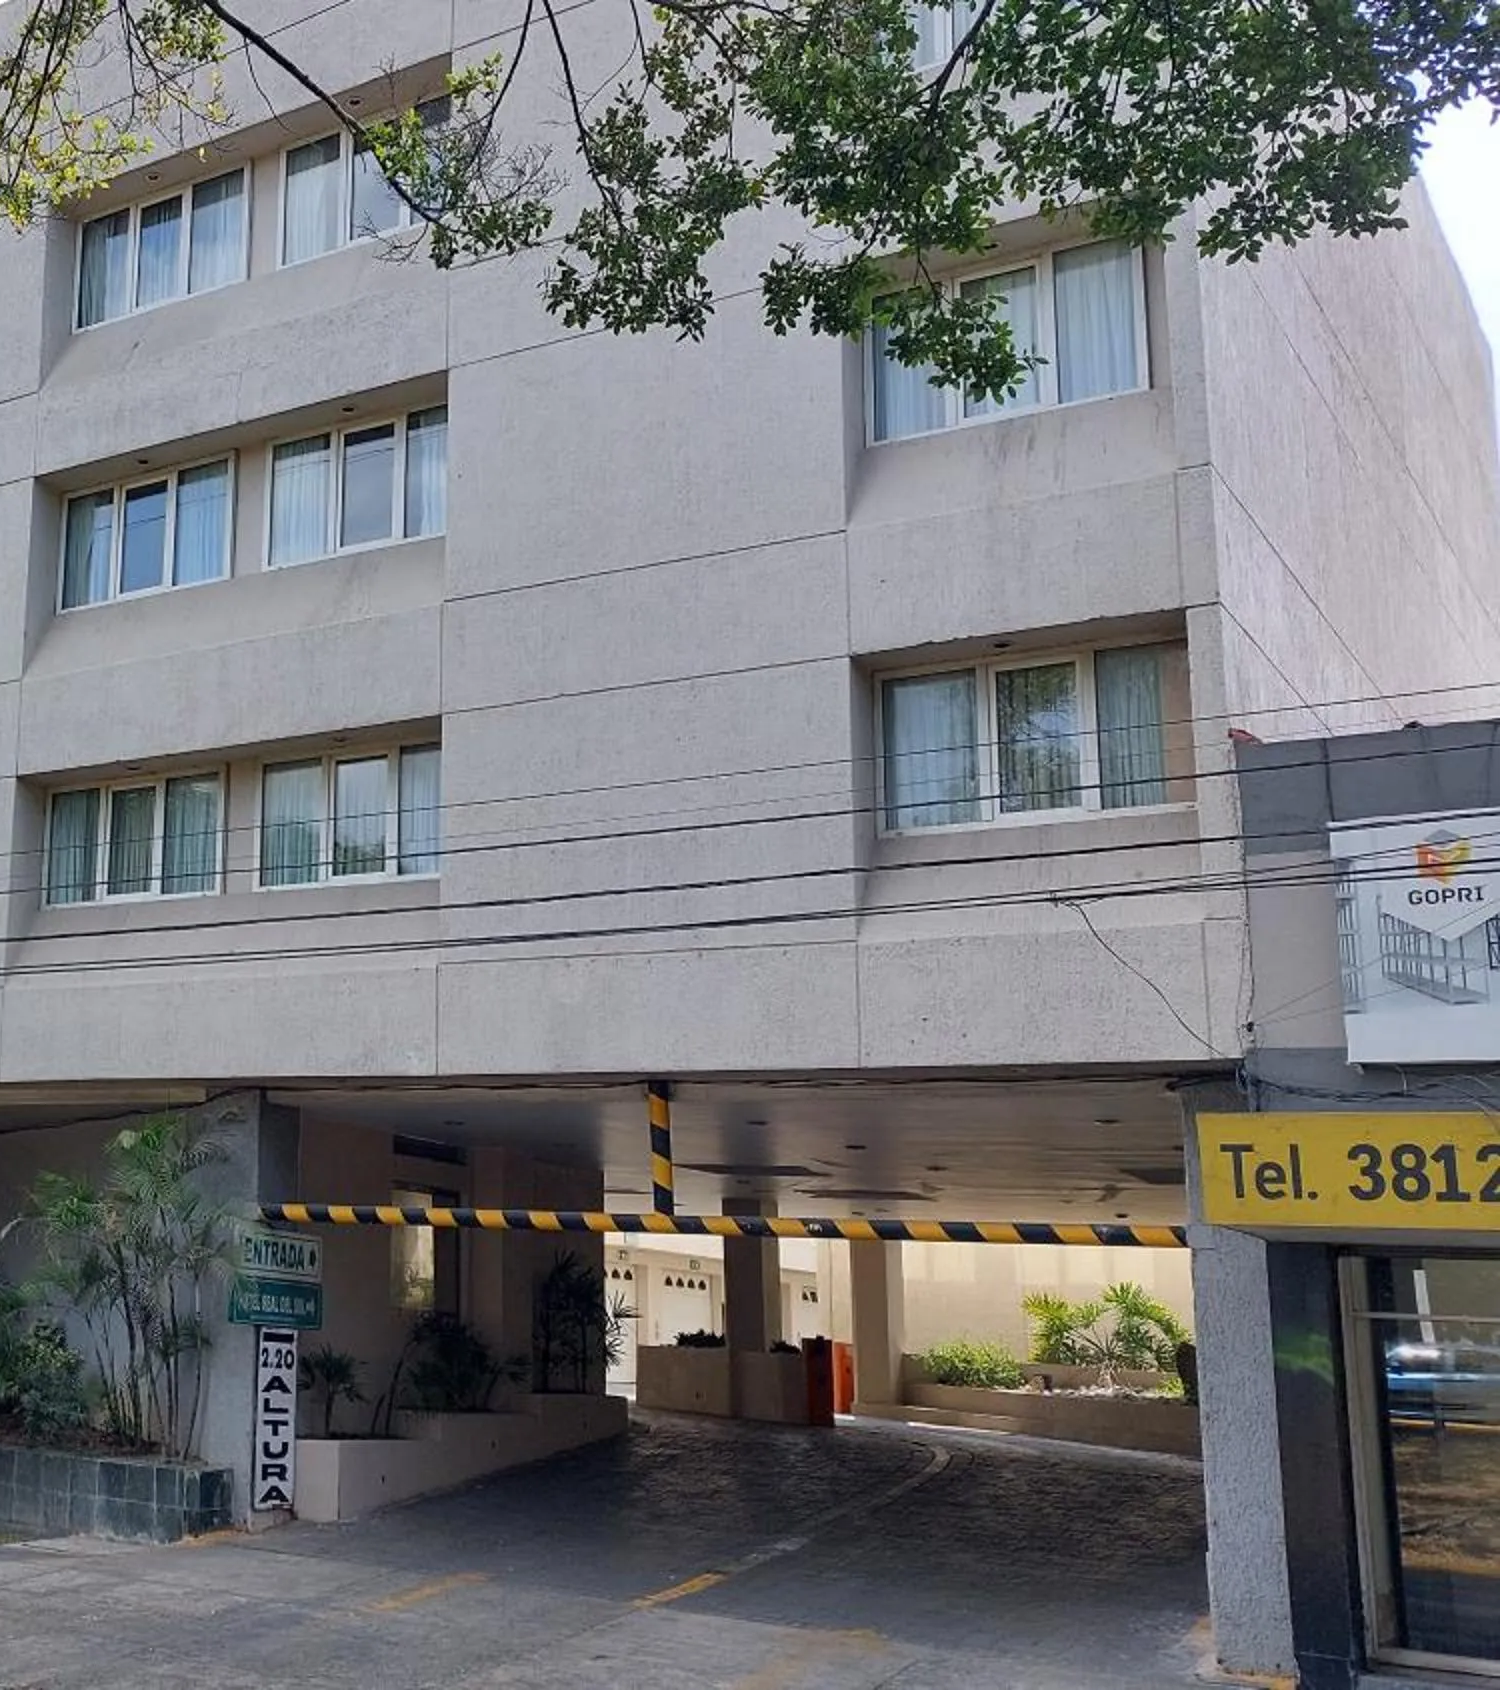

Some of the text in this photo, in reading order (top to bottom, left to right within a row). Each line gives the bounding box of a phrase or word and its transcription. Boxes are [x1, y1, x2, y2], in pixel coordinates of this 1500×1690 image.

[1407, 886, 1485, 906] GOPRI
[1219, 1143, 1500, 1203] Tel. 3812
[243, 1237, 305, 1270] ENTRADA
[261, 1348, 295, 1370] 2.20
[259, 1375, 293, 1504] ALTURA
